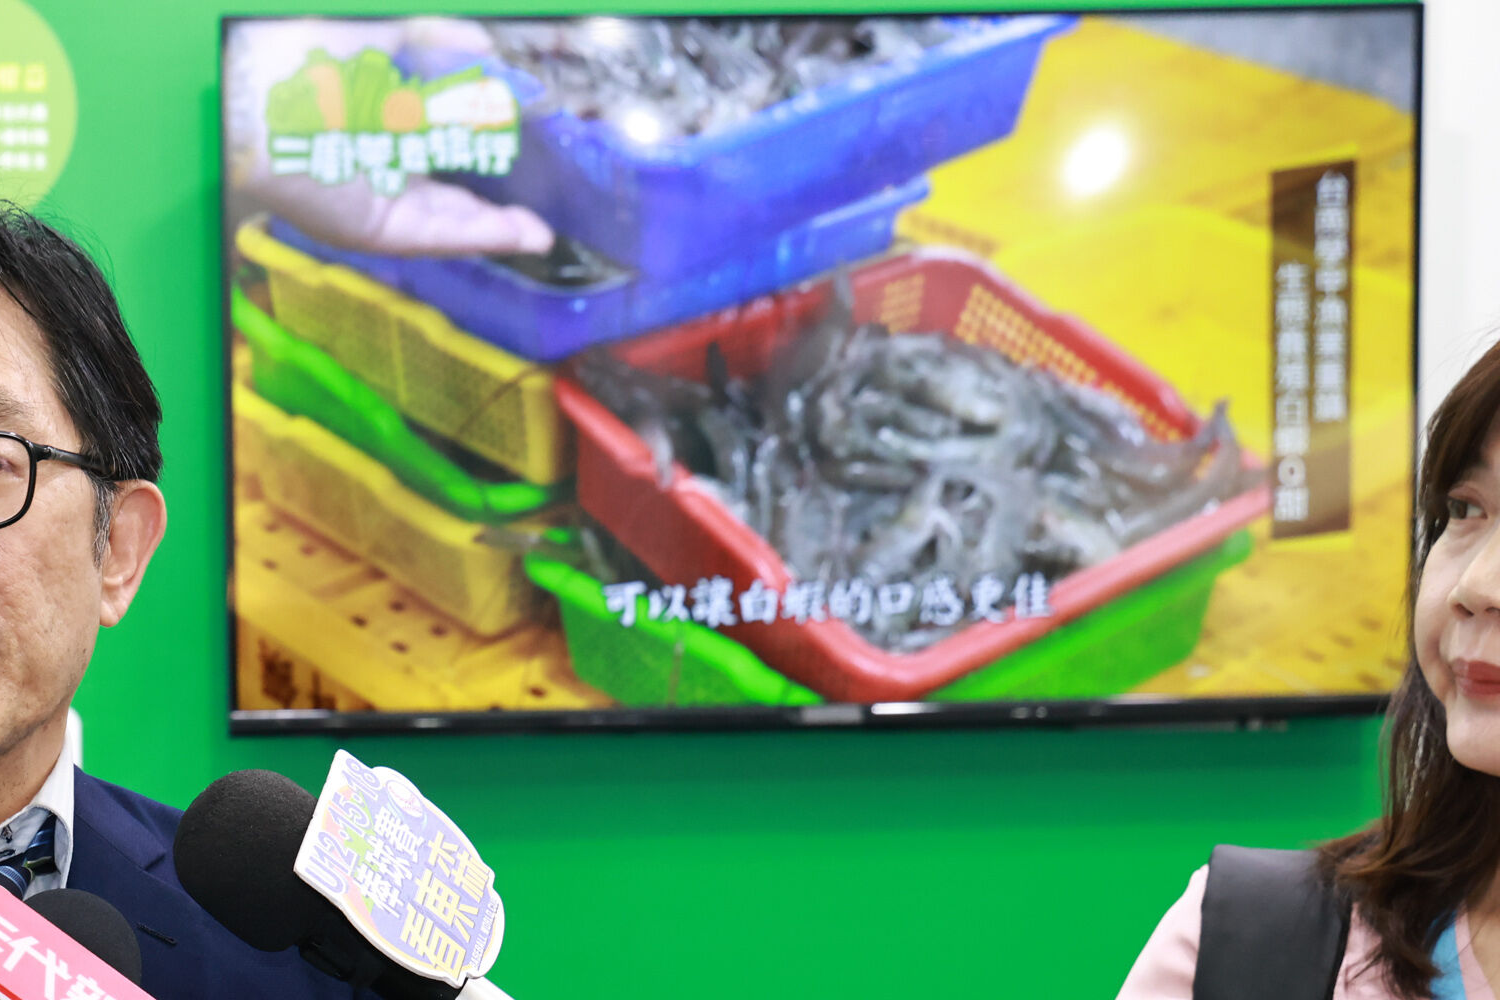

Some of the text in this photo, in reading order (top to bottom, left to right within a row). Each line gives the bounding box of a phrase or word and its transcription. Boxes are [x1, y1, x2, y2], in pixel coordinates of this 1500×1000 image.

[602, 572, 1054, 627] 可以讓白蝦的口感更佳
[356, 806, 426, 919] 棒球賽
[400, 831, 490, 980] 看東森
[469, 933, 488, 972] BASEBALL
